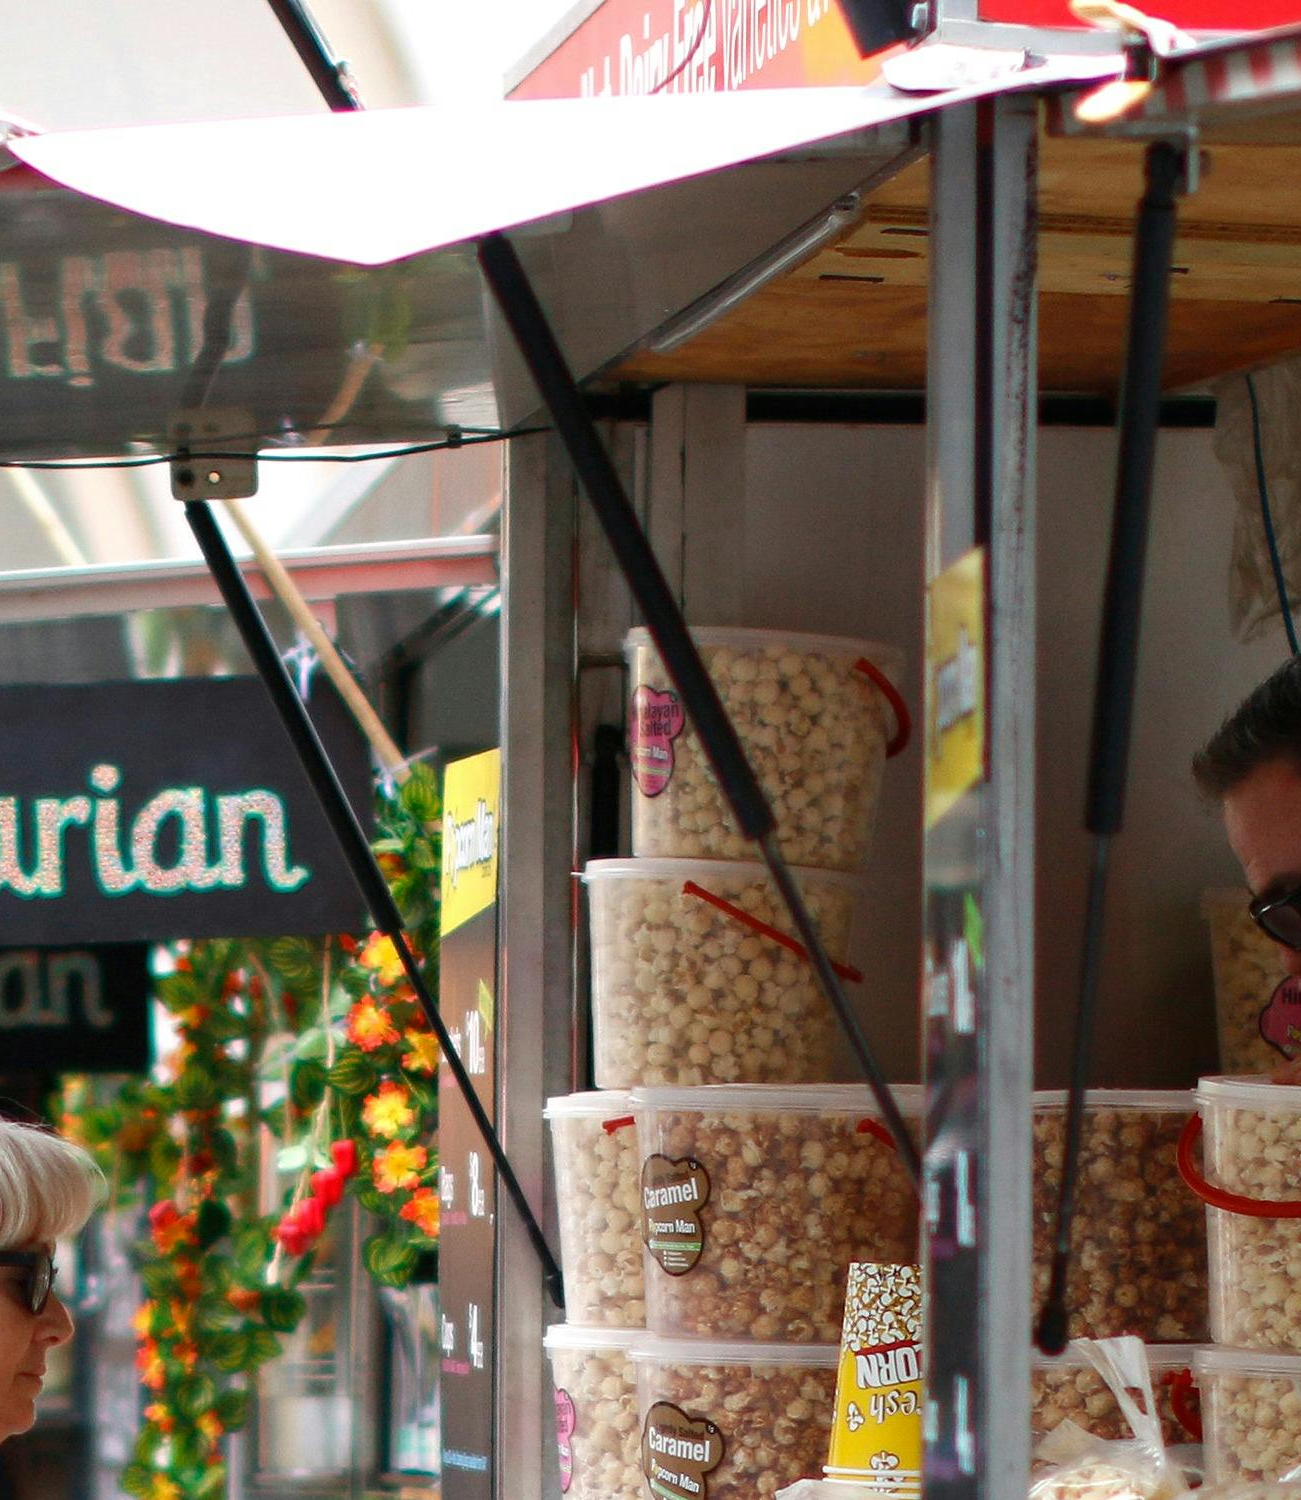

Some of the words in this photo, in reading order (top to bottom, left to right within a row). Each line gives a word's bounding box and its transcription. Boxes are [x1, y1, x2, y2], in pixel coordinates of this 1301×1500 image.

[643, 1177, 698, 1210] Caramel
[675, 1219, 696, 1234] Man
[870, 1390, 923, 1424] esh
[648, 1426, 711, 1462] Caramel
[679, 1473, 699, 1493] Man
